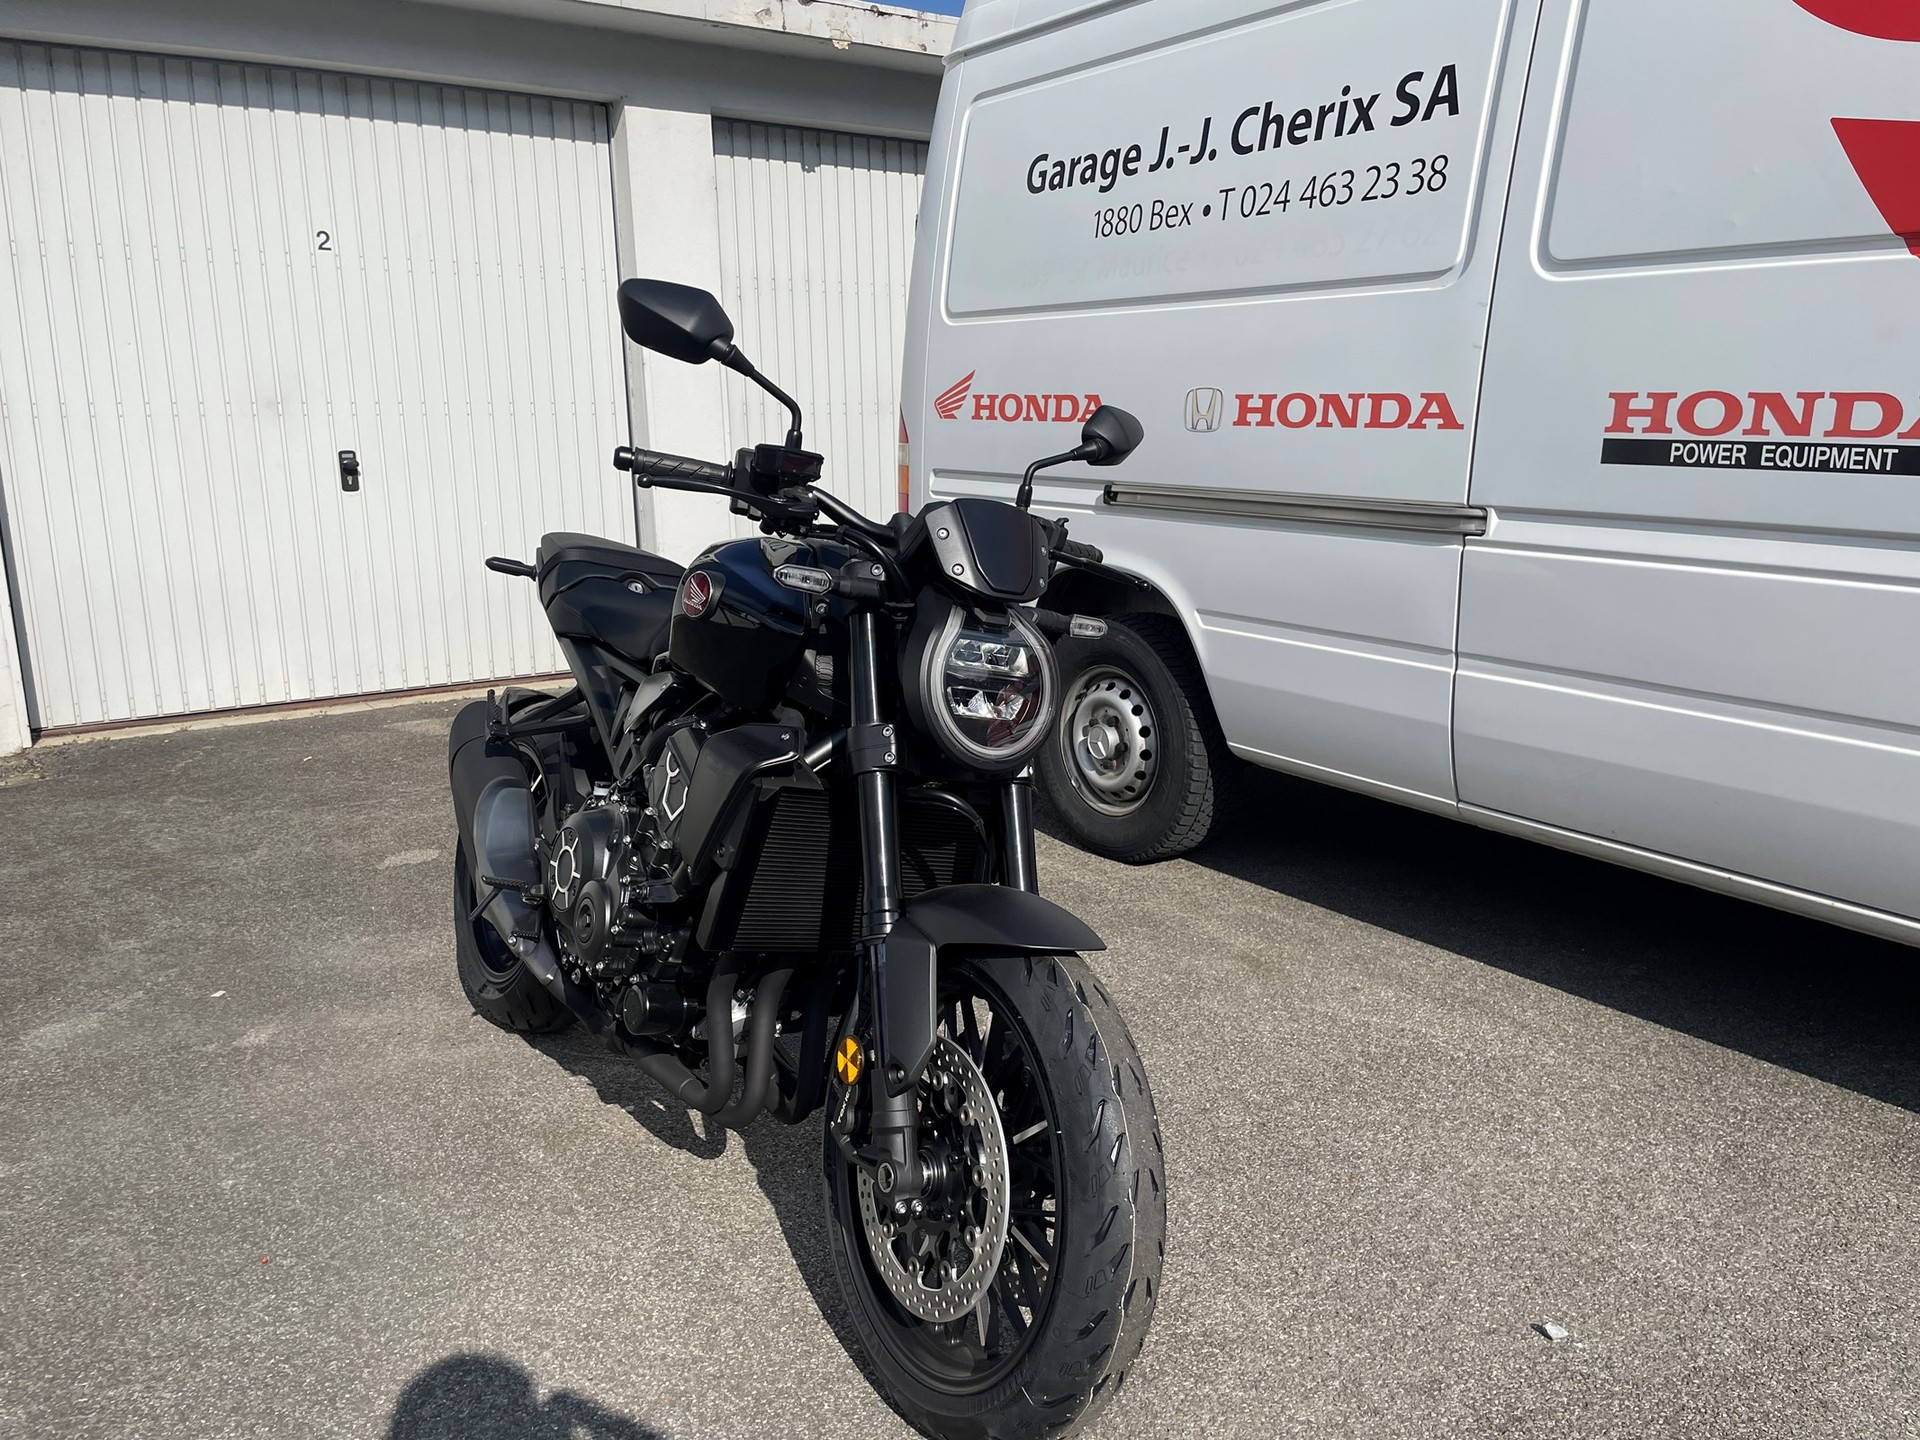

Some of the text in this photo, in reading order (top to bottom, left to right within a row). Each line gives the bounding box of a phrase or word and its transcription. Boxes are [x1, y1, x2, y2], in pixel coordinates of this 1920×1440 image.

[1026, 63, 1460, 195] Garage J.-J. Cherix SA
[1093, 203, 1143, 239] 1880
[1148, 199, 1194, 231] Bex
[1218, 187, 1237, 221] T
[1239, 179, 1291, 219] 024
[1298, 169, 1355, 209] 463
[1360, 162, 1401, 202] 23
[1405, 154, 1449, 196] 38
[316, 230, 332, 251] 2
[973, 393, 1103, 423] HONDA
[1232, 392, 1464, 430] HONDA
[1669, 442, 1899, 471] POWER EQUIPMENT
